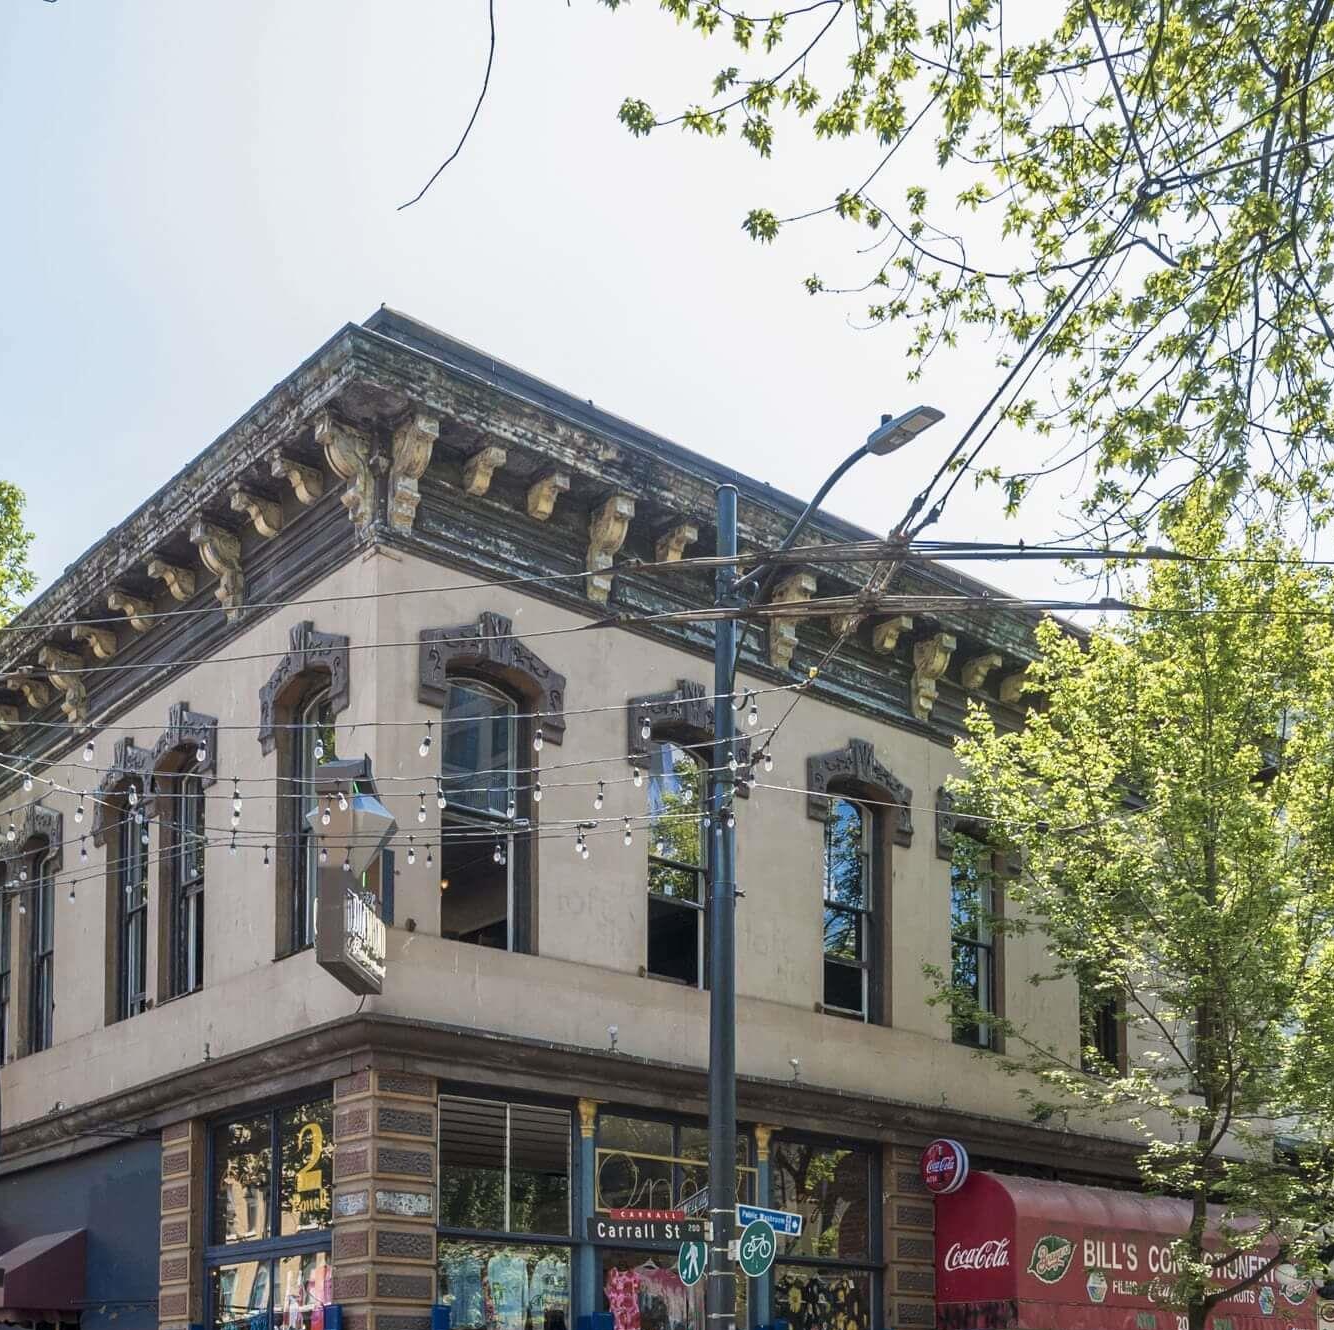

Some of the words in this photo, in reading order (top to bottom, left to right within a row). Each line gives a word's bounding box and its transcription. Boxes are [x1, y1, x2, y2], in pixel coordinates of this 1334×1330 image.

[620, 1211, 676, 1220] CARRALL
[597, 1222, 655, 1239] Carrall
[665, 1224, 681, 1240] St
[688, 1224, 700, 1232] 200
[1083, 1239, 1138, 1271] BILL'S
[1148, 1244, 1276, 1284] CONCTIONERY
